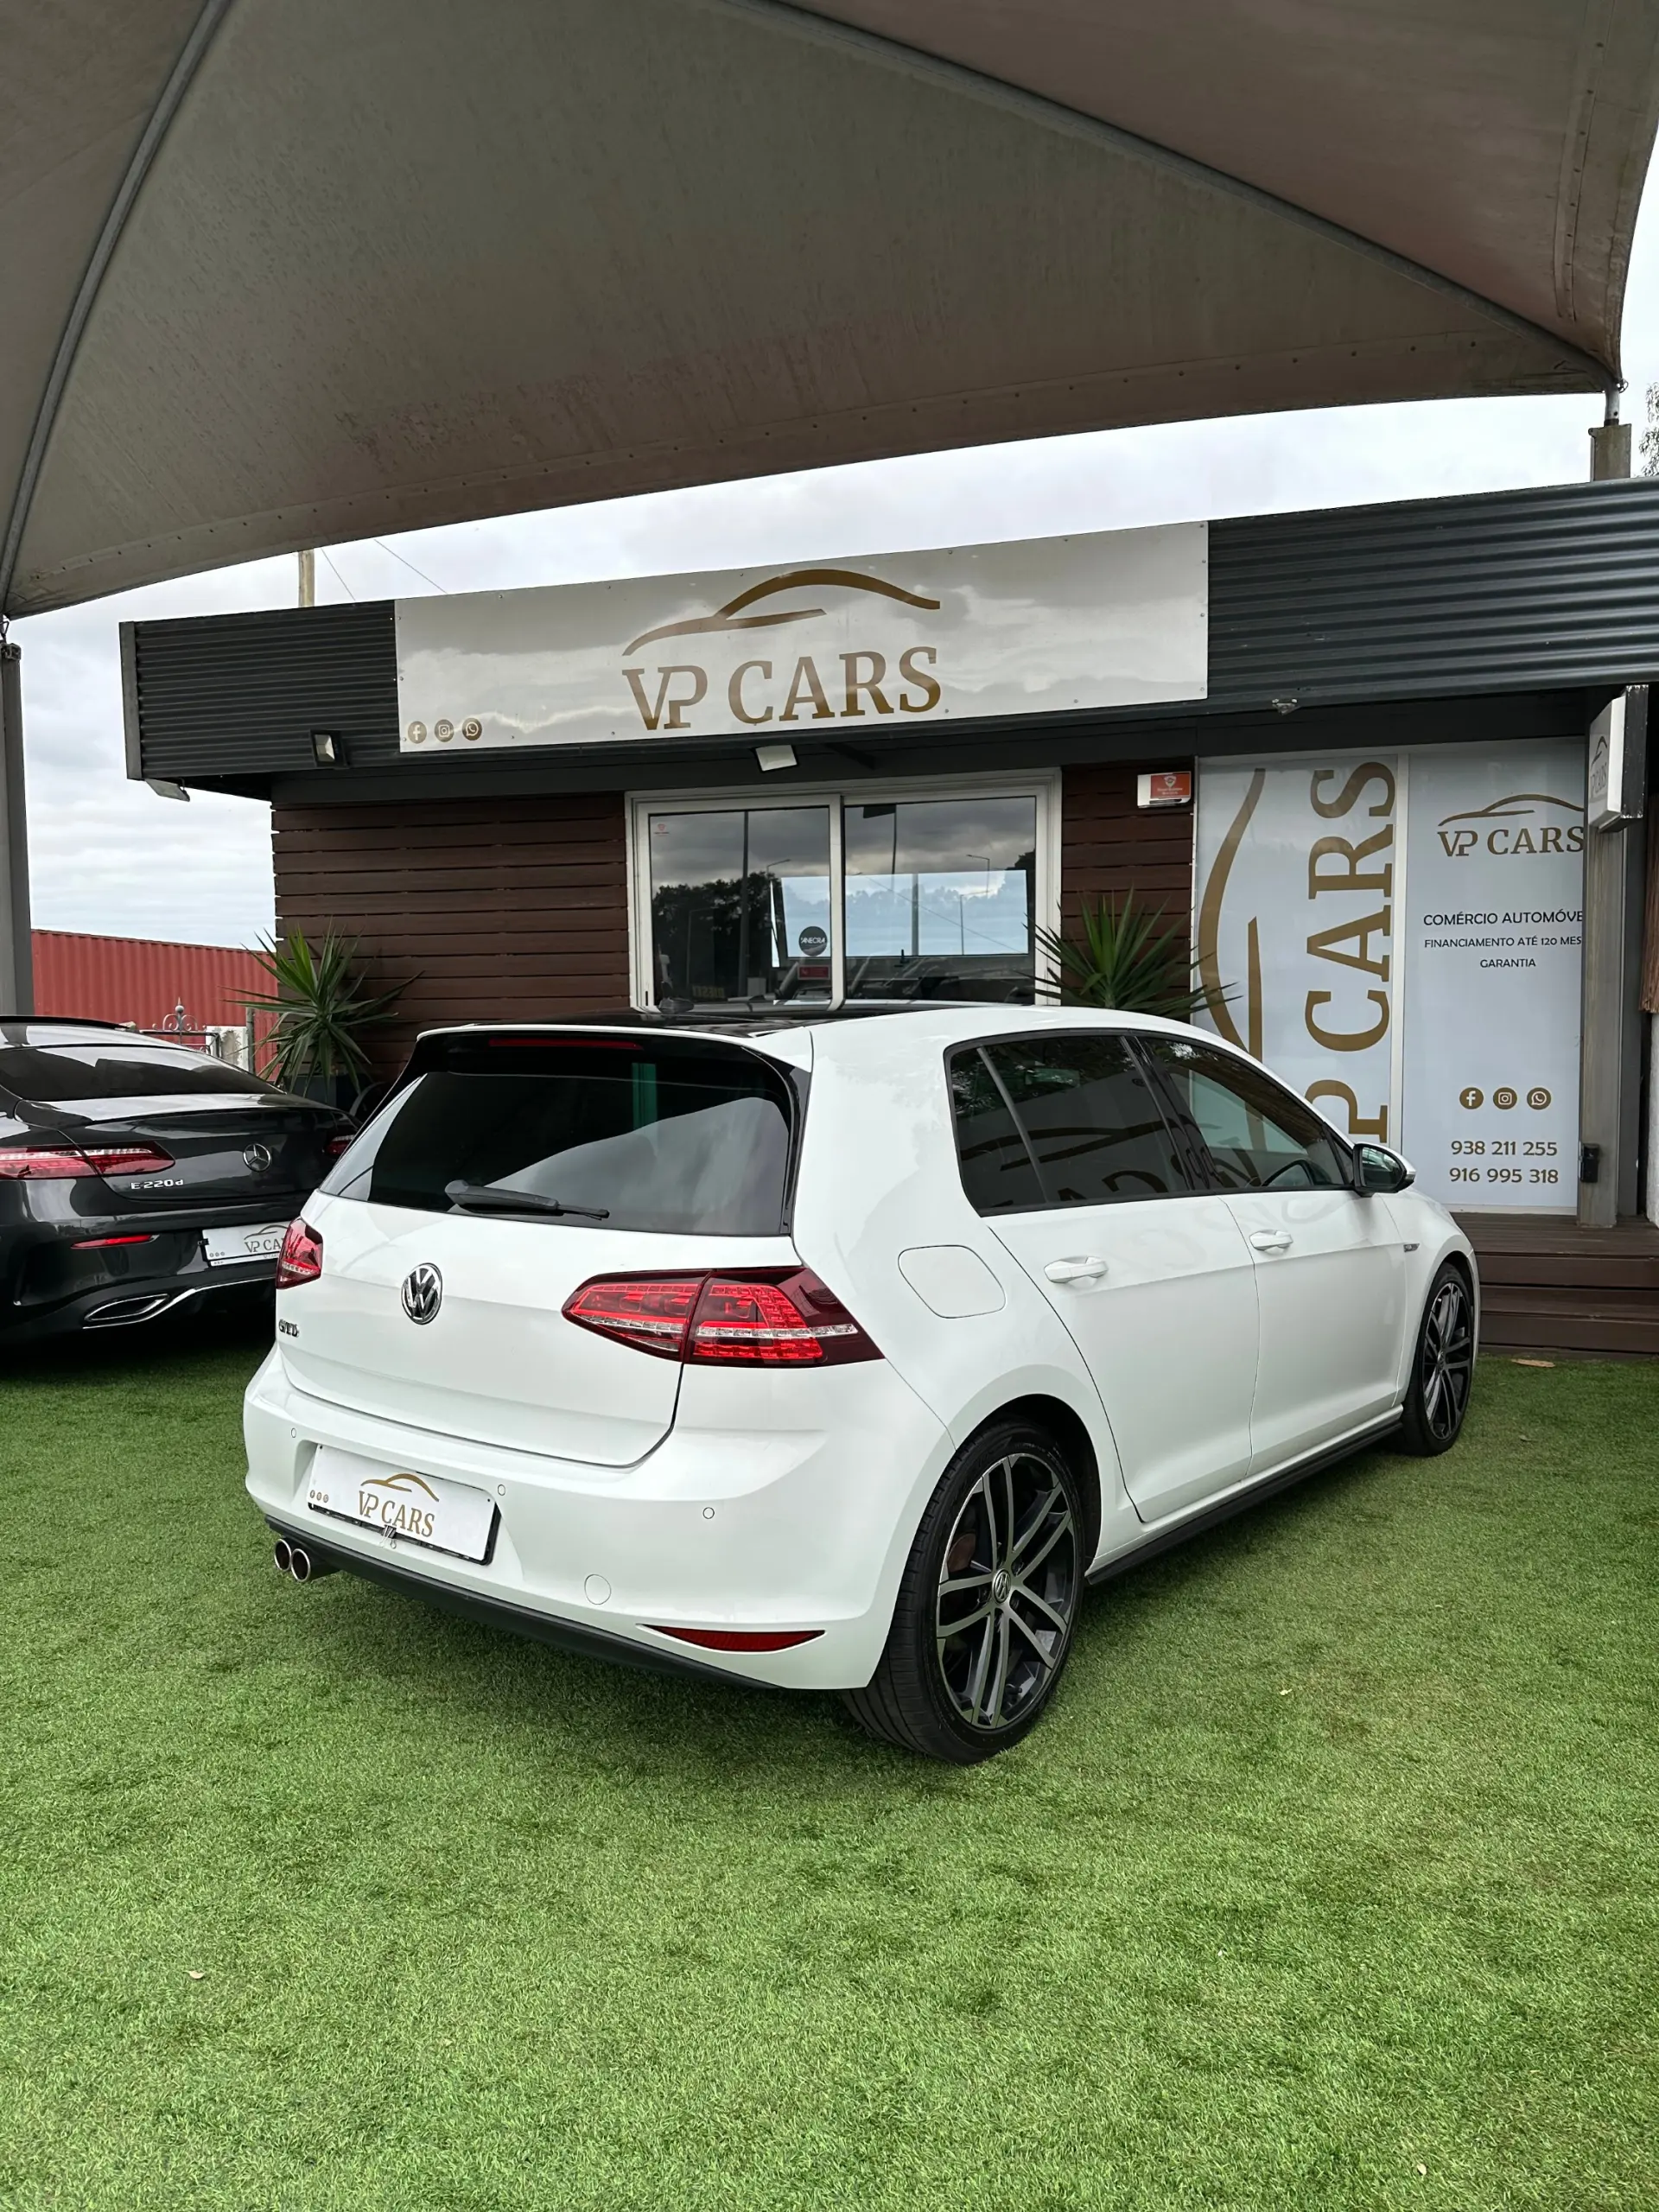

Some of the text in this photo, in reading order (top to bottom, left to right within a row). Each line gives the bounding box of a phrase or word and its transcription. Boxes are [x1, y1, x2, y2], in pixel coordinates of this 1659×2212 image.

[622, 646, 941, 730] VP CARS
[1437, 825, 1585, 857] VP CARS
[1423, 912, 1497, 925] COMÉRCIO
[1424, 936, 1582, 948] FINANCIAMENTO ATÉ 120 MES
[1304, 761, 1395, 1143] P CARS
[1479, 958, 1536, 969] GARANTIA
[1451, 1140, 1558, 1157] 938 211 255
[1449, 1167, 1559, 1184] 916 995 318
[263, 1237, 285, 1251] CA
[359, 1490, 435, 1538] VP CARS
